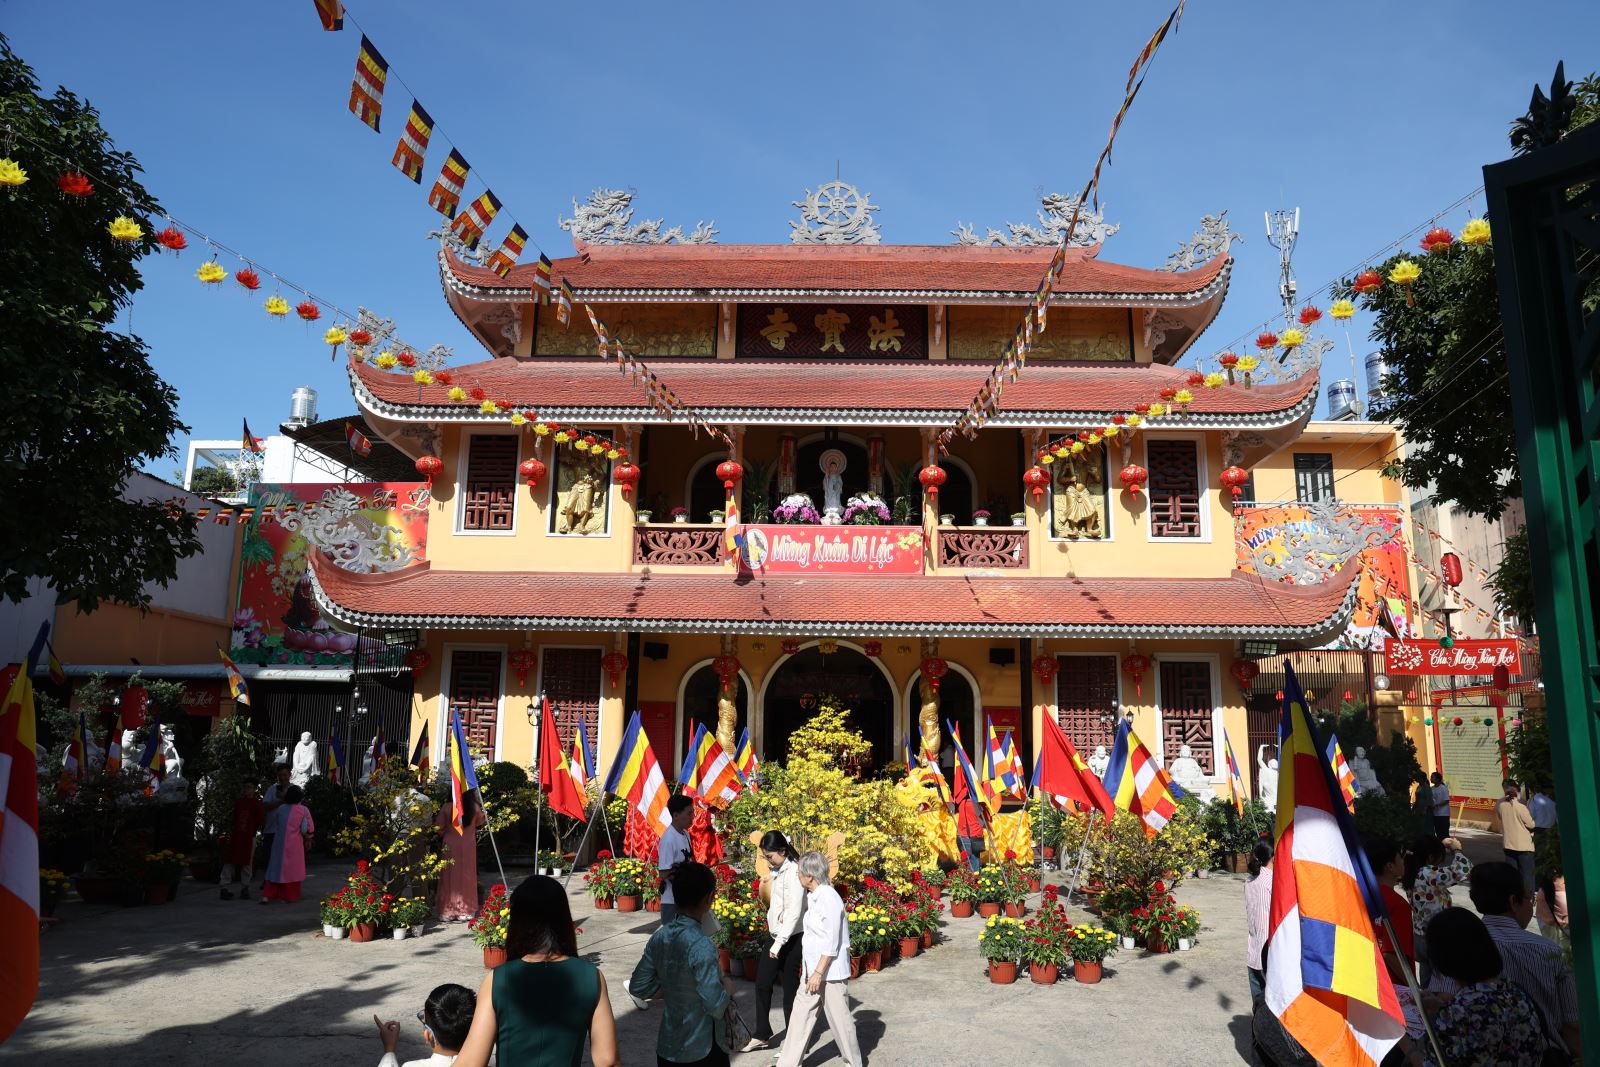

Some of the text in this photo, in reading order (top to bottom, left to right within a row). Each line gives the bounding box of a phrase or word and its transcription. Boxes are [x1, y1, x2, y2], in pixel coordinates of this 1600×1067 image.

[771, 534, 894, 569] Mừng Xuân Di Lặc
[1477, 648, 1496, 665] Năm
[1494, 647, 1517, 667] Mới
